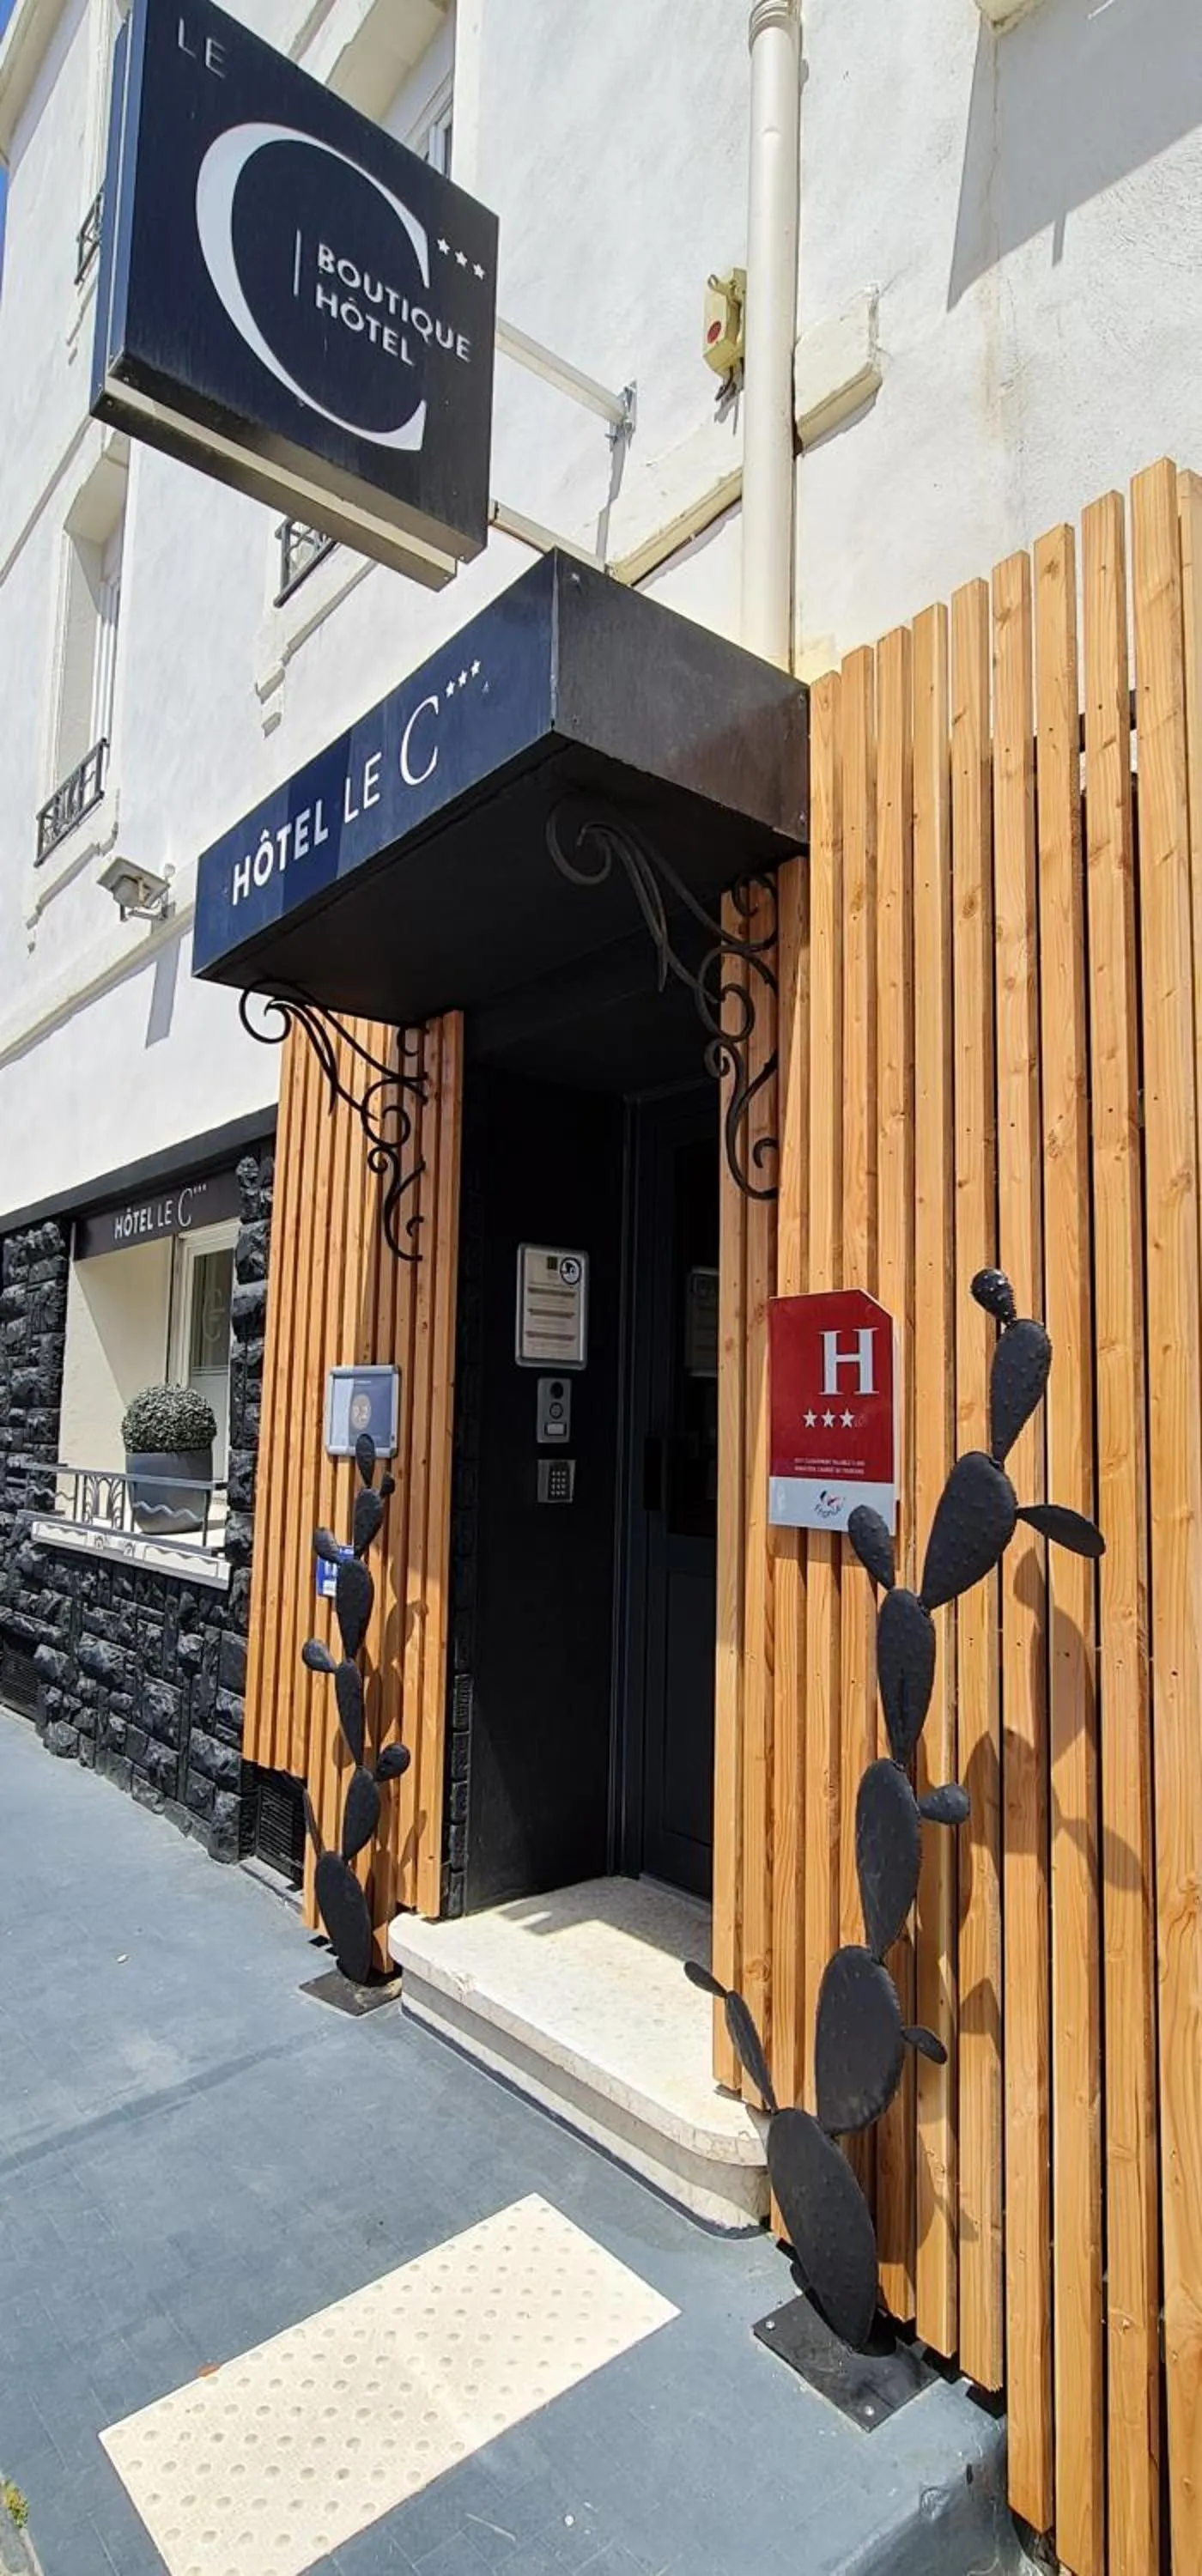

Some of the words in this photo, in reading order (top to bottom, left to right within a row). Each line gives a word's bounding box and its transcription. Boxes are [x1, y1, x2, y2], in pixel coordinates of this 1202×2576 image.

[177, 17, 227, 79] LE
[196, 122, 429, 450] C
[314, 283, 415, 368] HÔTEL
[318, 242, 472, 363] BOUTIQUE
[232, 799, 329, 905] HÔTEL
[344, 751, 382, 823] LE
[400, 696, 440, 786] C
[114, 1207, 153, 1239] HÔTEL
[158, 1200, 173, 1226] LE
[178, 1188, 192, 1226] C
[818, 1327, 880, 1395] H
